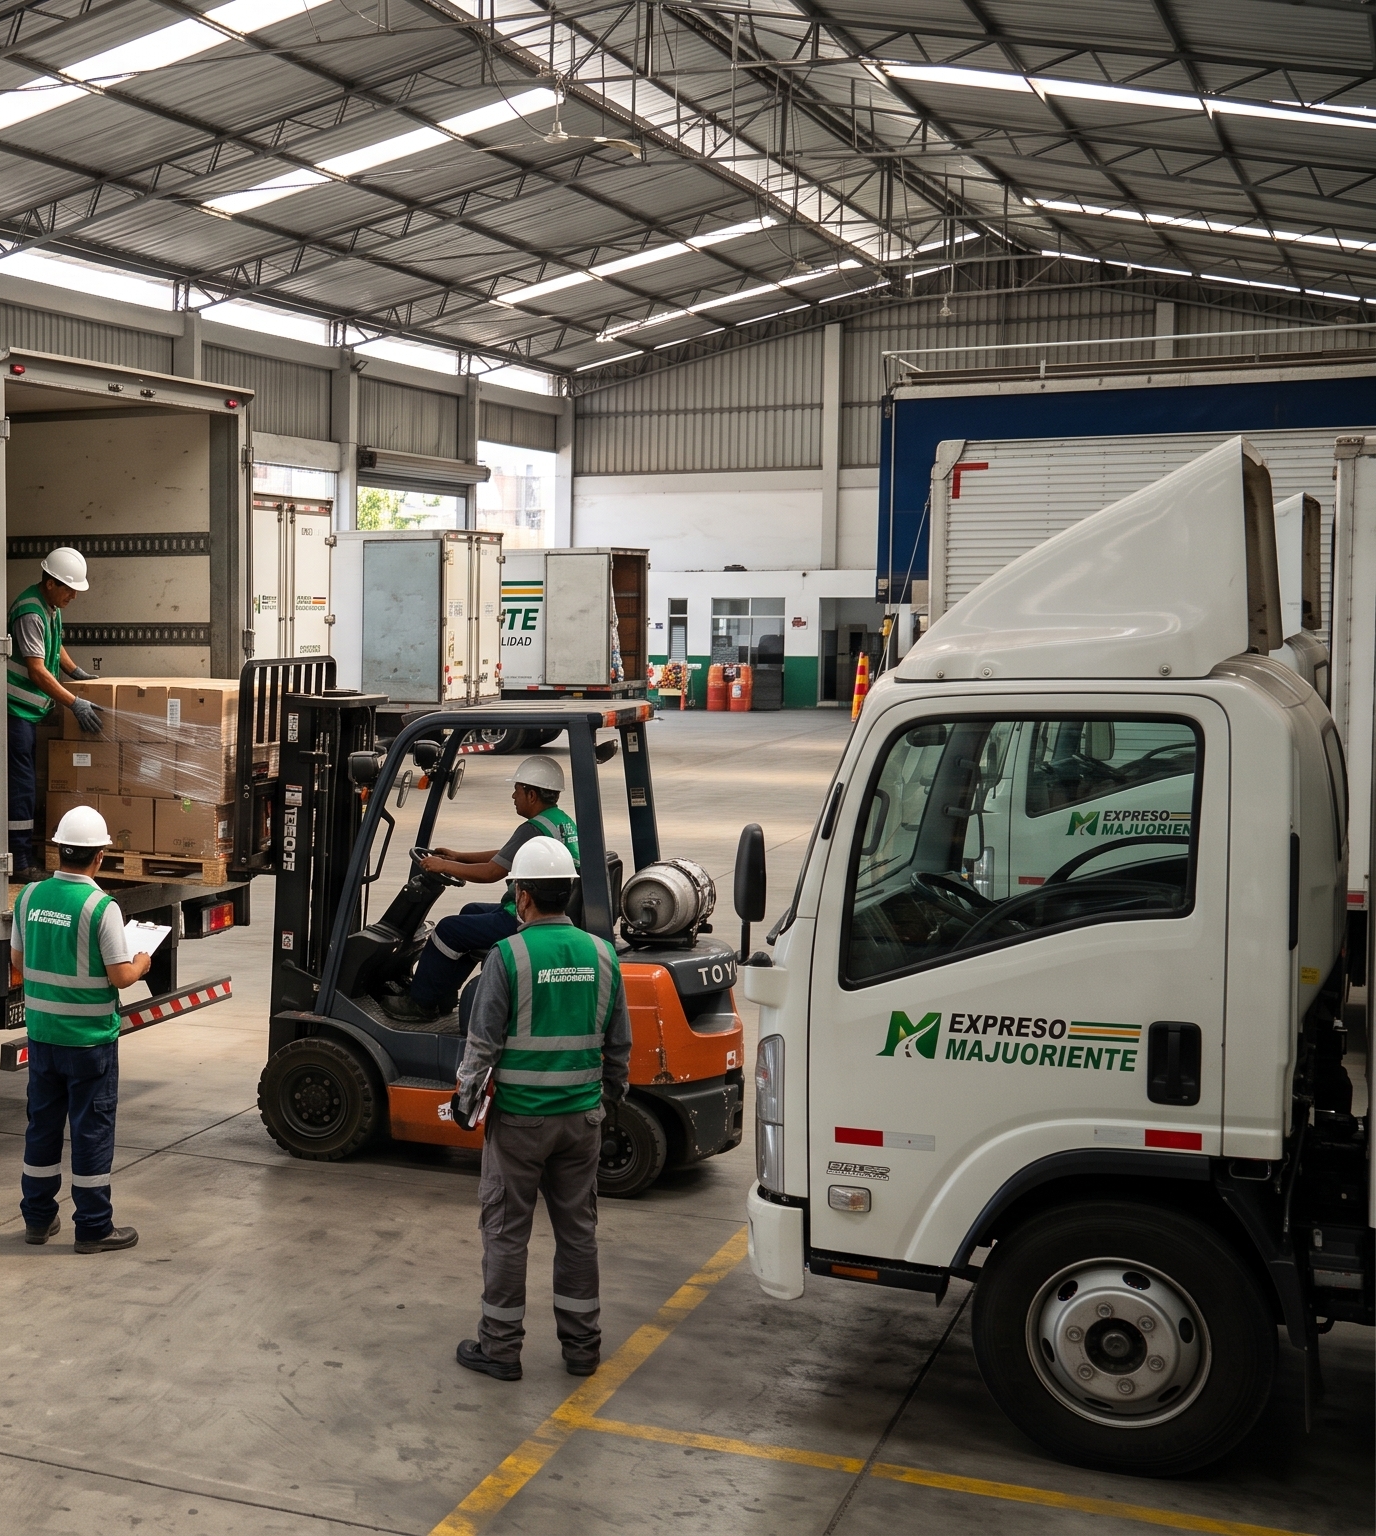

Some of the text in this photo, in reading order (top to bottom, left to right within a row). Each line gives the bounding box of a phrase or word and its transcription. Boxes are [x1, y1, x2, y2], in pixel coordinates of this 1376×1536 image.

[501, 636, 532, 646] LIDAD
[1103, 810, 1170, 822] EXPRESO
[948, 1013, 1067, 1039] EXPRESO
[945, 1038, 1139, 1072] MAJUORIENTE
